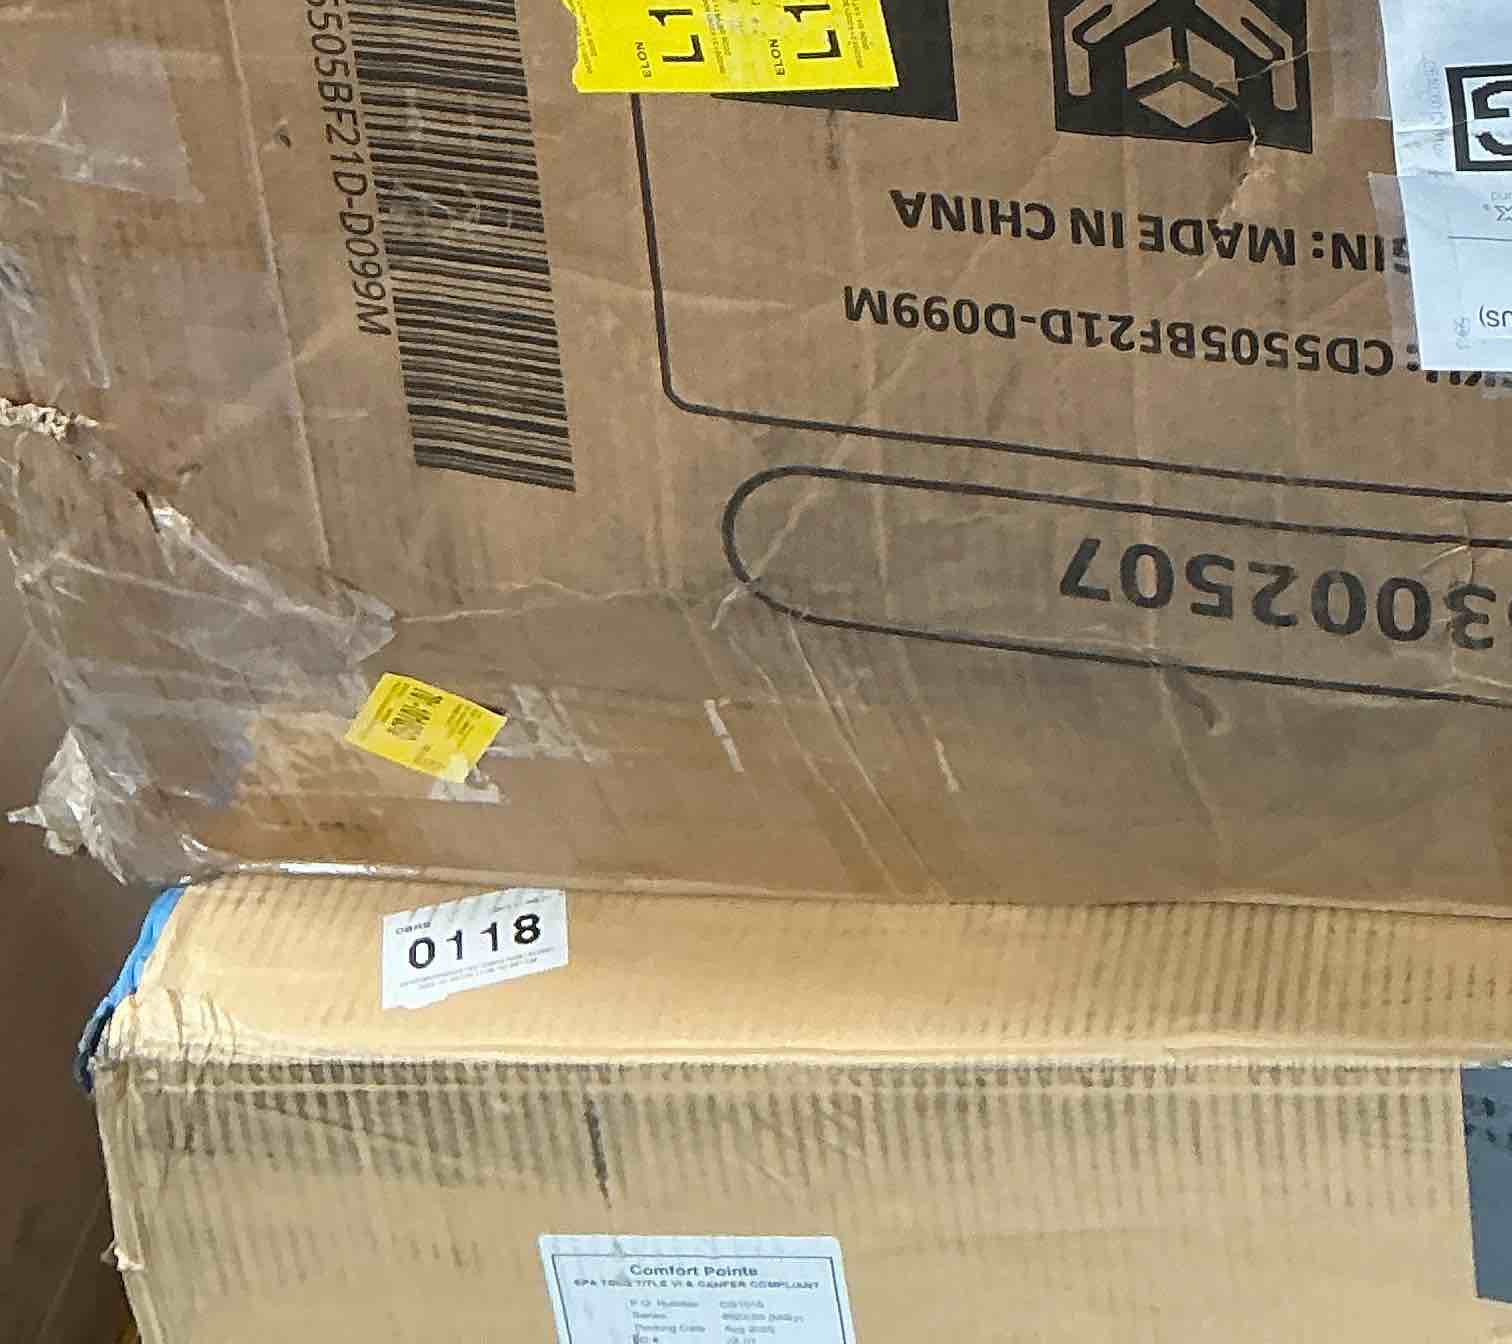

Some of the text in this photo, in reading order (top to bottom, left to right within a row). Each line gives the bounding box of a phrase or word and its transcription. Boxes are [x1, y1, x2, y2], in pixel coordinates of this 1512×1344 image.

[634, 40, 653, 78] ELON
[769, 38, 786, 76] ELON
[887, 189, 1054, 242] CHINA
[1070, 207, 1124, 250] IN
[1137, 211, 1295, 267] MADE
[841, 285, 1395, 377] CD5505BF21D-D099M
[408, 913, 541, 969] 0118
[629, 1263, 700, 1277] Comfort
